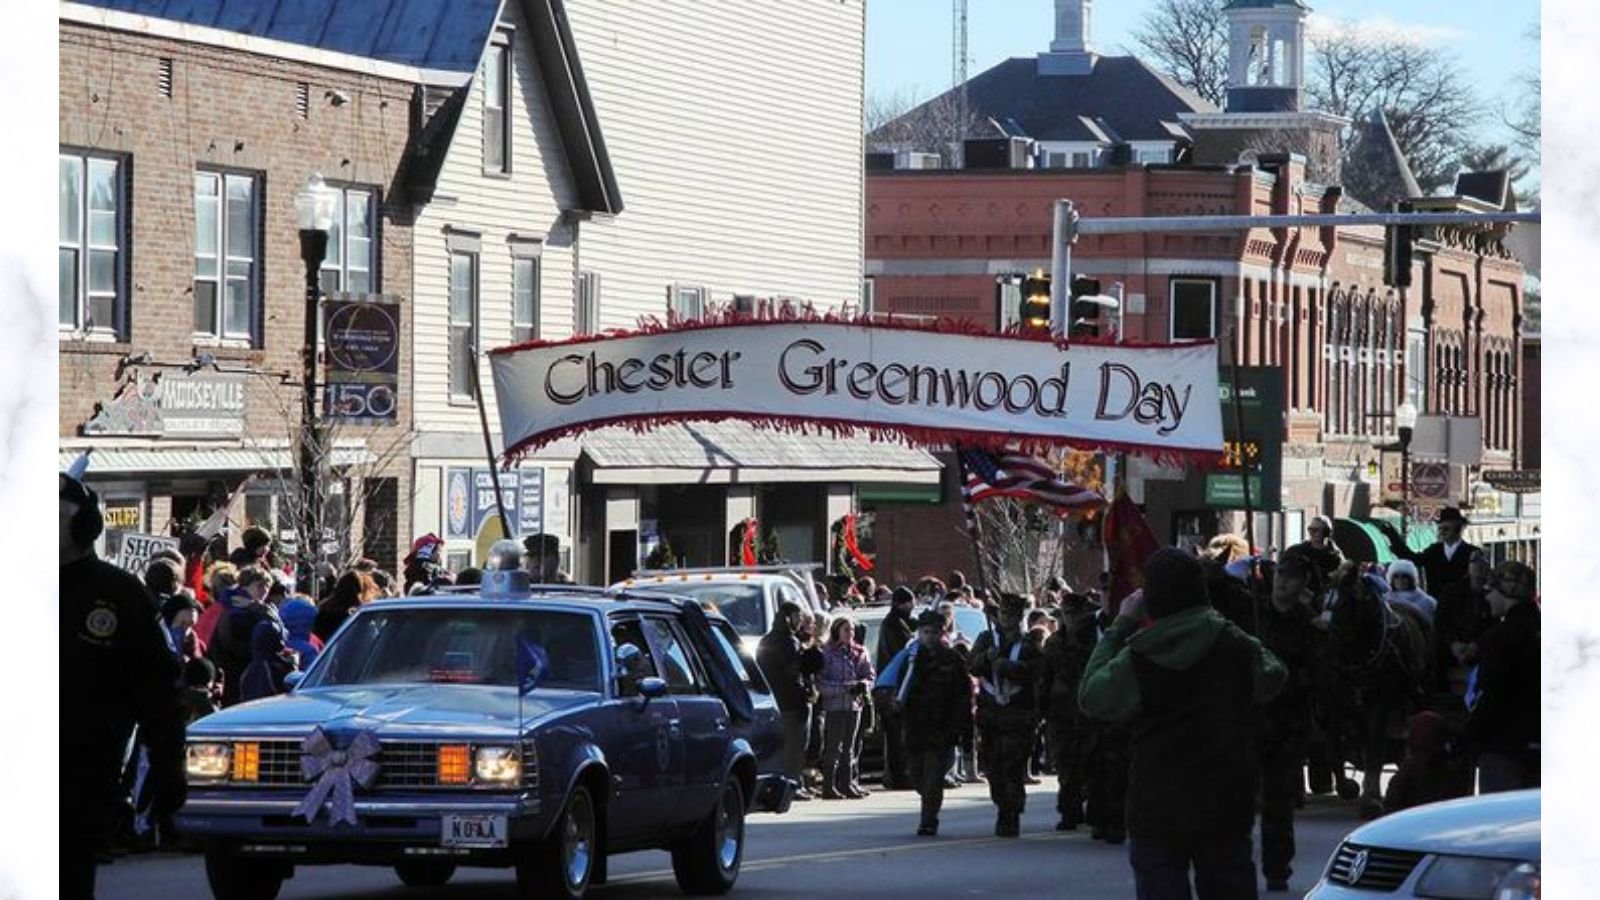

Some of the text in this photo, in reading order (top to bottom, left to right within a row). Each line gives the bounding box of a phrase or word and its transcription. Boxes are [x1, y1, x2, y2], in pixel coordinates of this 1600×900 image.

[326, 384, 394, 416] 150
[544, 339, 1192, 436] Chester Greenwood Day
